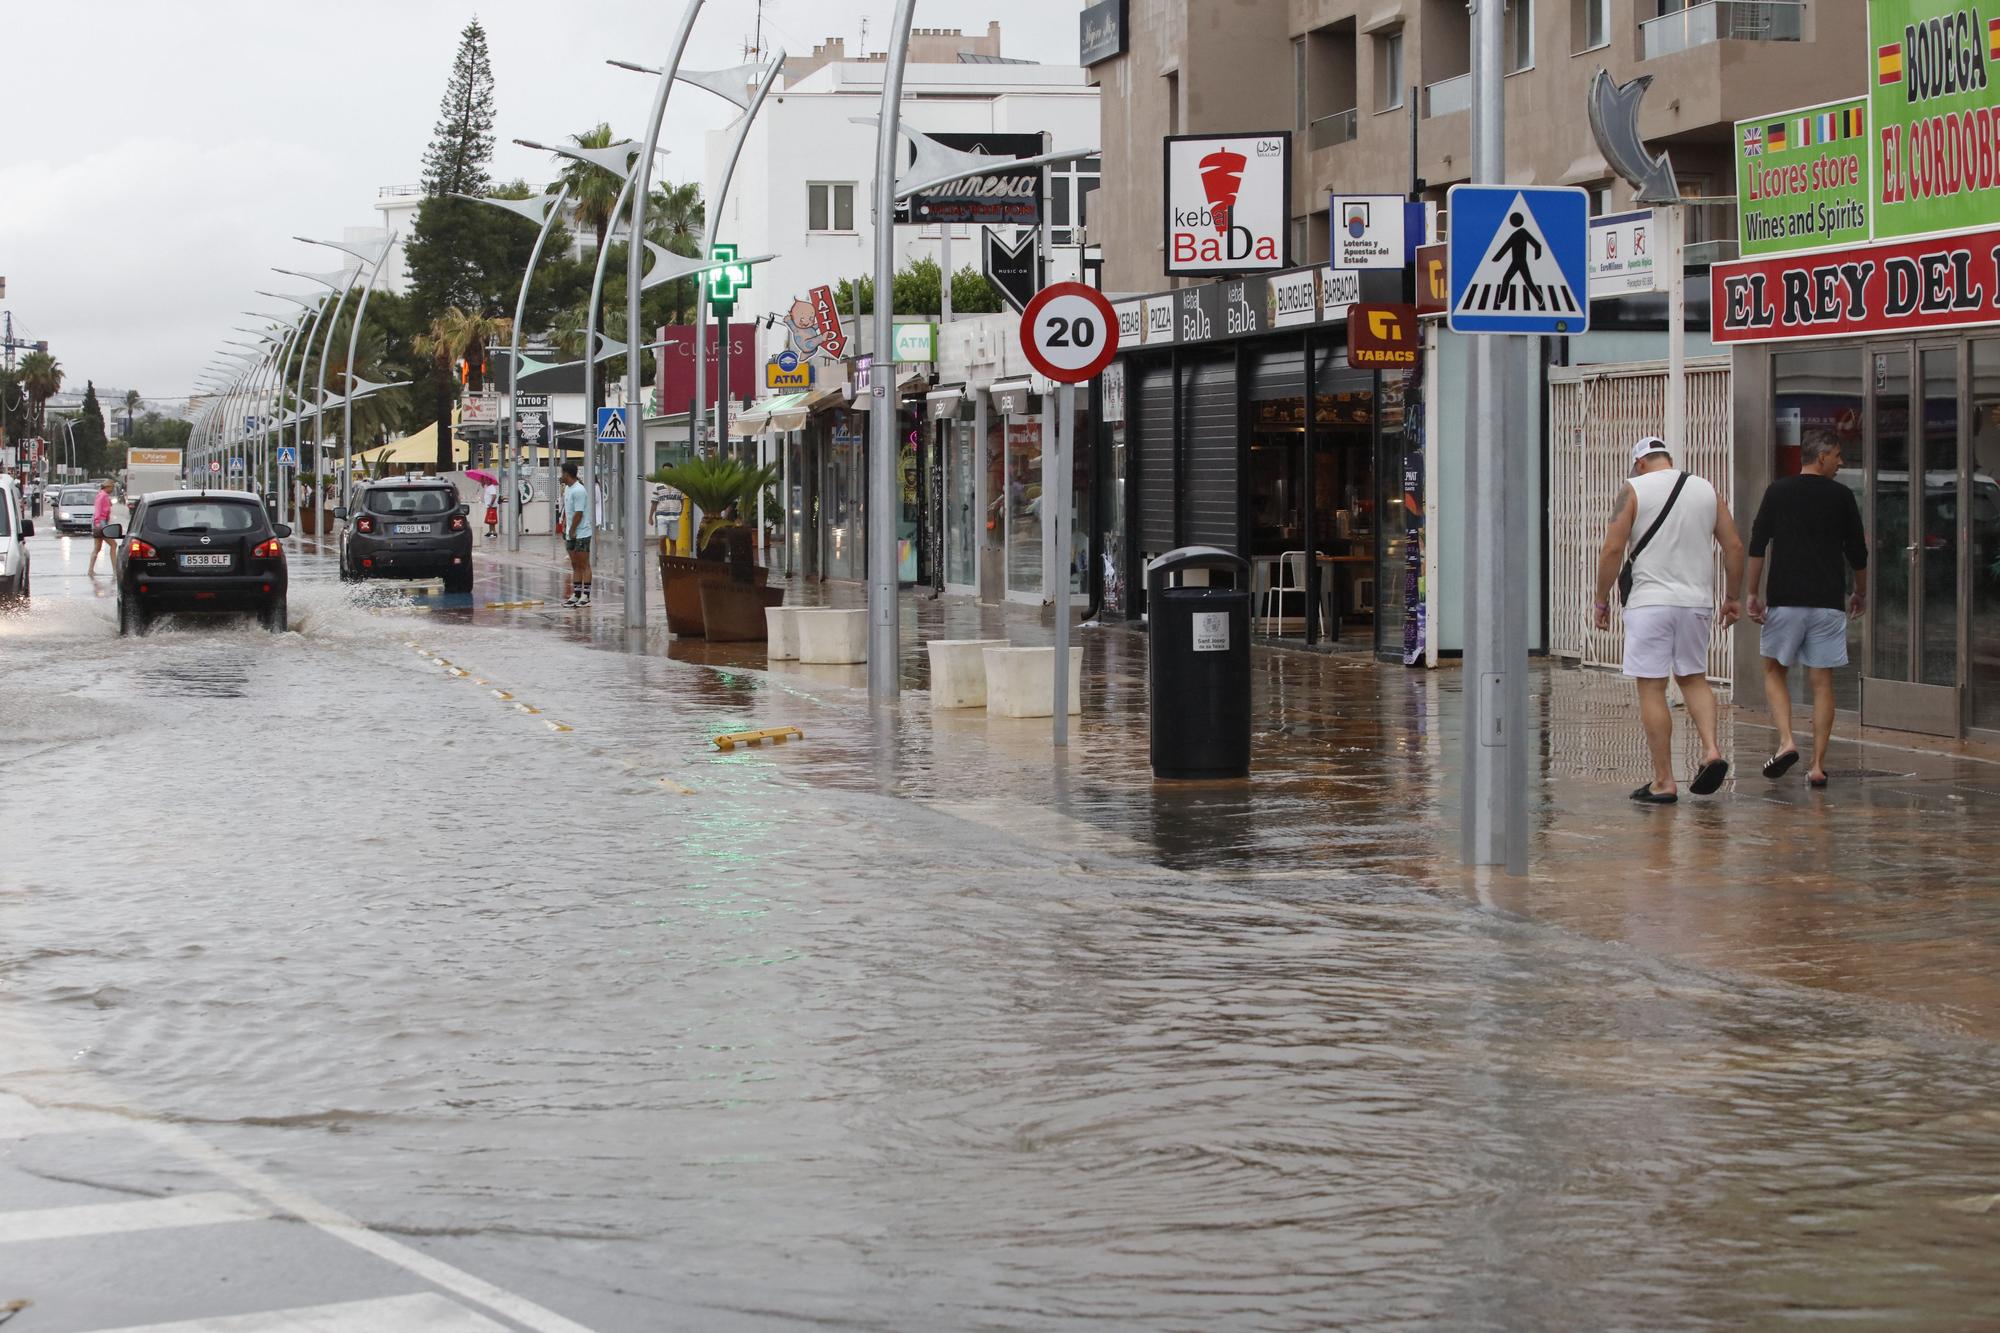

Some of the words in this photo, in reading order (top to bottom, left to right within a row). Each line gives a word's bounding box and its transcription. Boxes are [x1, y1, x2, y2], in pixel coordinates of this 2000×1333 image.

[1905, 7, 1987, 104] BODEGA
[1748, 163, 1808, 201] Licores
[1812, 153, 1859, 189] store
[1882, 124, 1905, 205] EL
[918, 175, 1037, 197] mnesia
[1745, 212, 1786, 242] Wines
[1788, 209, 1815, 236] and
[1818, 198, 1865, 239] Spirits
[1344, 248, 1376, 256] Apuestas
[1279, 282, 1314, 311] BURGUER
[1324, 275, 1358, 303] BARBACOA
[1724, 273, 1775, 331] EL
[1782, 261, 1875, 326] REY
[1884, 249, 1983, 318] DEL
[814, 289, 840, 351] TATTOO
[1046, 317, 1094, 347] 20
[1150, 306, 1172, 330] PIZZA
[900, 337, 929, 349] ATM
[1356, 350, 1415, 361] TABACS
[774, 374, 803, 384] ATM
[187, 555, 209, 565] 8538
[211, 555, 228, 564] GLF
